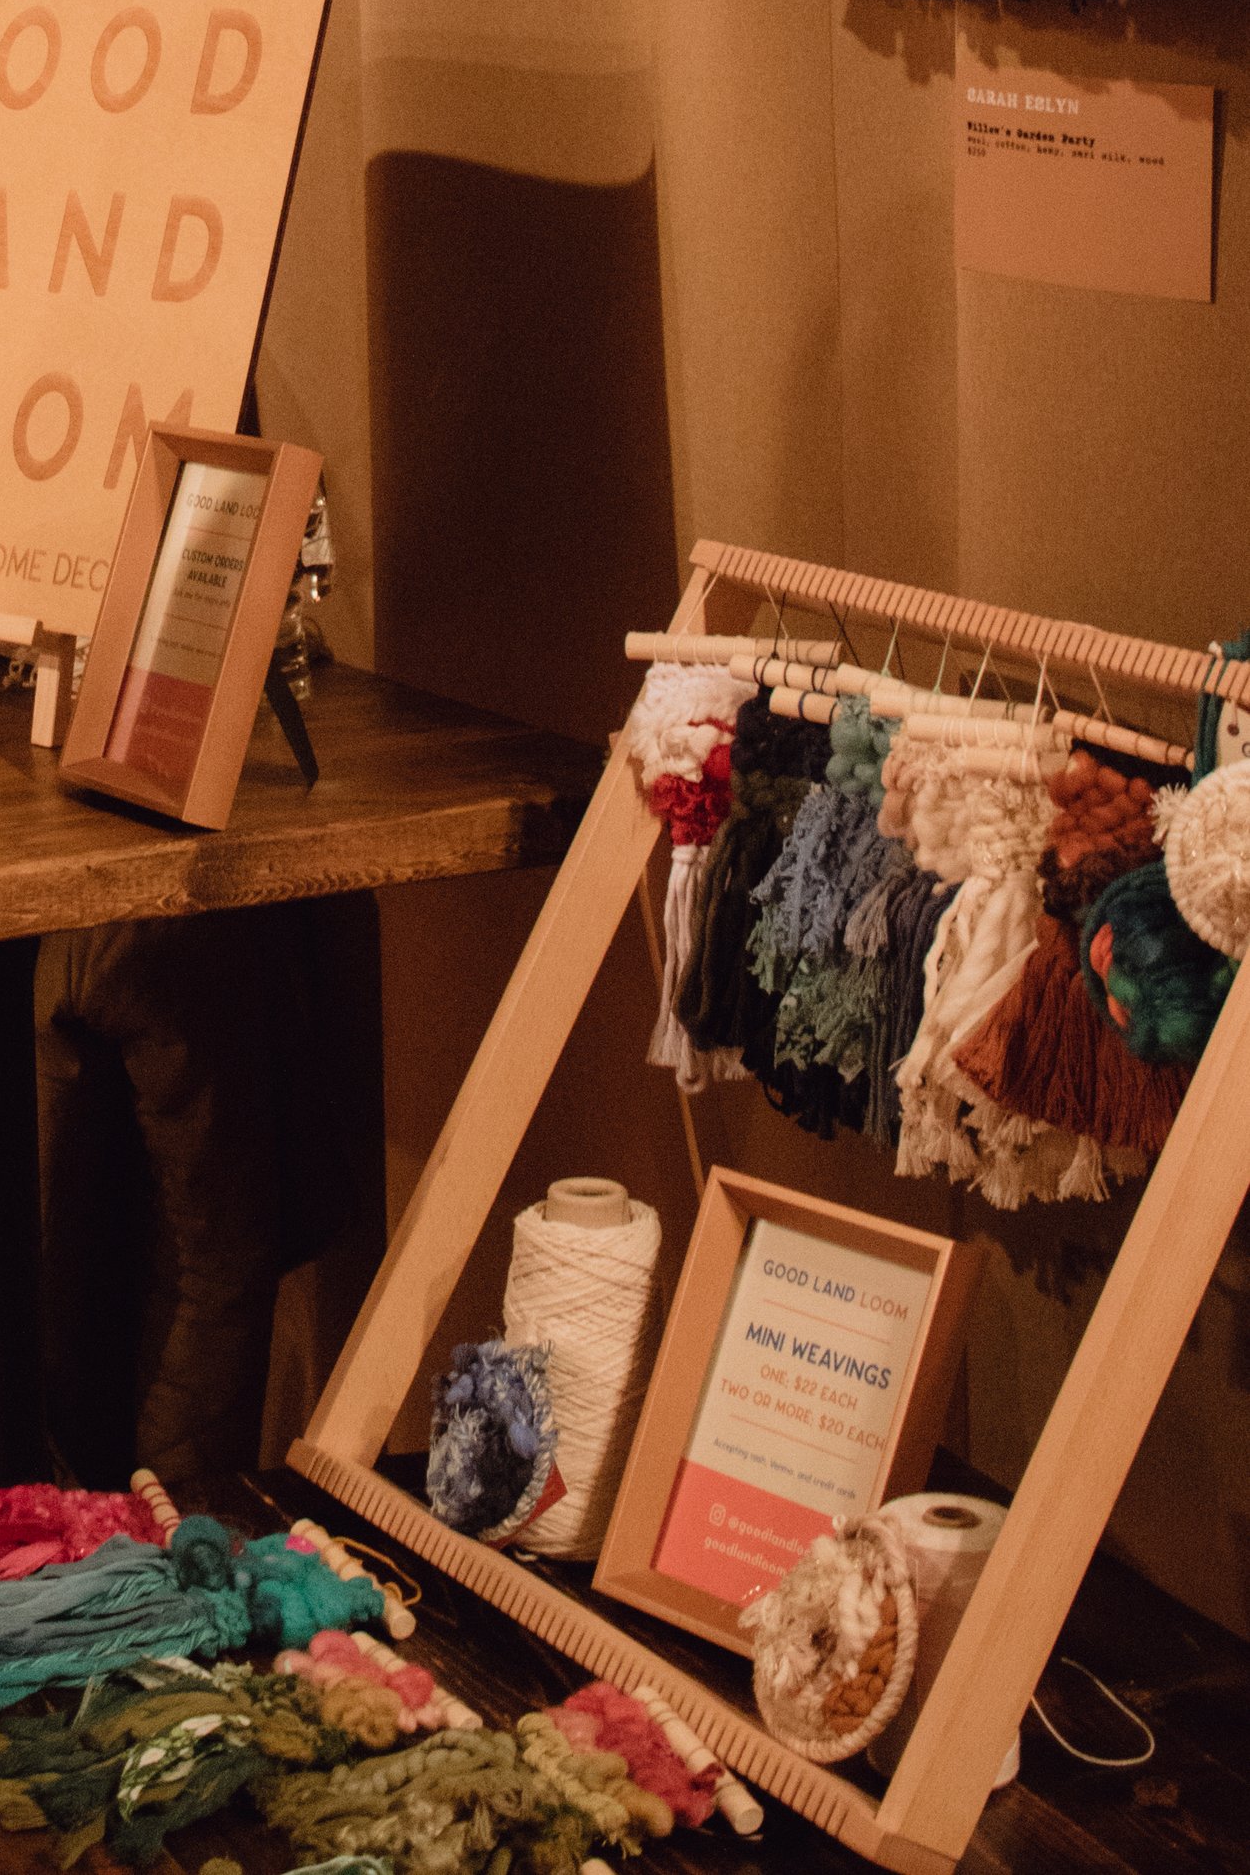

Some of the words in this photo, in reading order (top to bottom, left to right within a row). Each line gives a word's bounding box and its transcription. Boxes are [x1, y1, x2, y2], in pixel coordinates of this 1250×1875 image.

[967, 87, 1018, 109] SARAH
[1017, 128, 1055, 143] Garden
[1060, 133, 1096, 148] Party
[186, 494, 213, 511] GOOD
[214, 499, 239, 516] LAND
[182, 548, 214, 565] CUSTOM
[187, 570, 228, 589] AVAILABLE
[763, 1259, 809, 1286] GOOD
[813, 1275, 855, 1303] LAND
[860, 1292, 908, 1321] LOOM
[745, 1322, 786, 1352] MINI
[791, 1337, 892, 1390] WEAVINGS
[760, 1364, 789, 1389] ONE:
[794, 1374, 818, 1396] $22
[819, 1386, 858, 1411] EACH
[720, 1378, 749, 1401] TWO
[753, 1391, 771, 1409] OR
[775, 1398, 813, 1427] MORE:
[818, 1415, 844, 1436] $20
[847, 1426, 887, 1452] EACH
